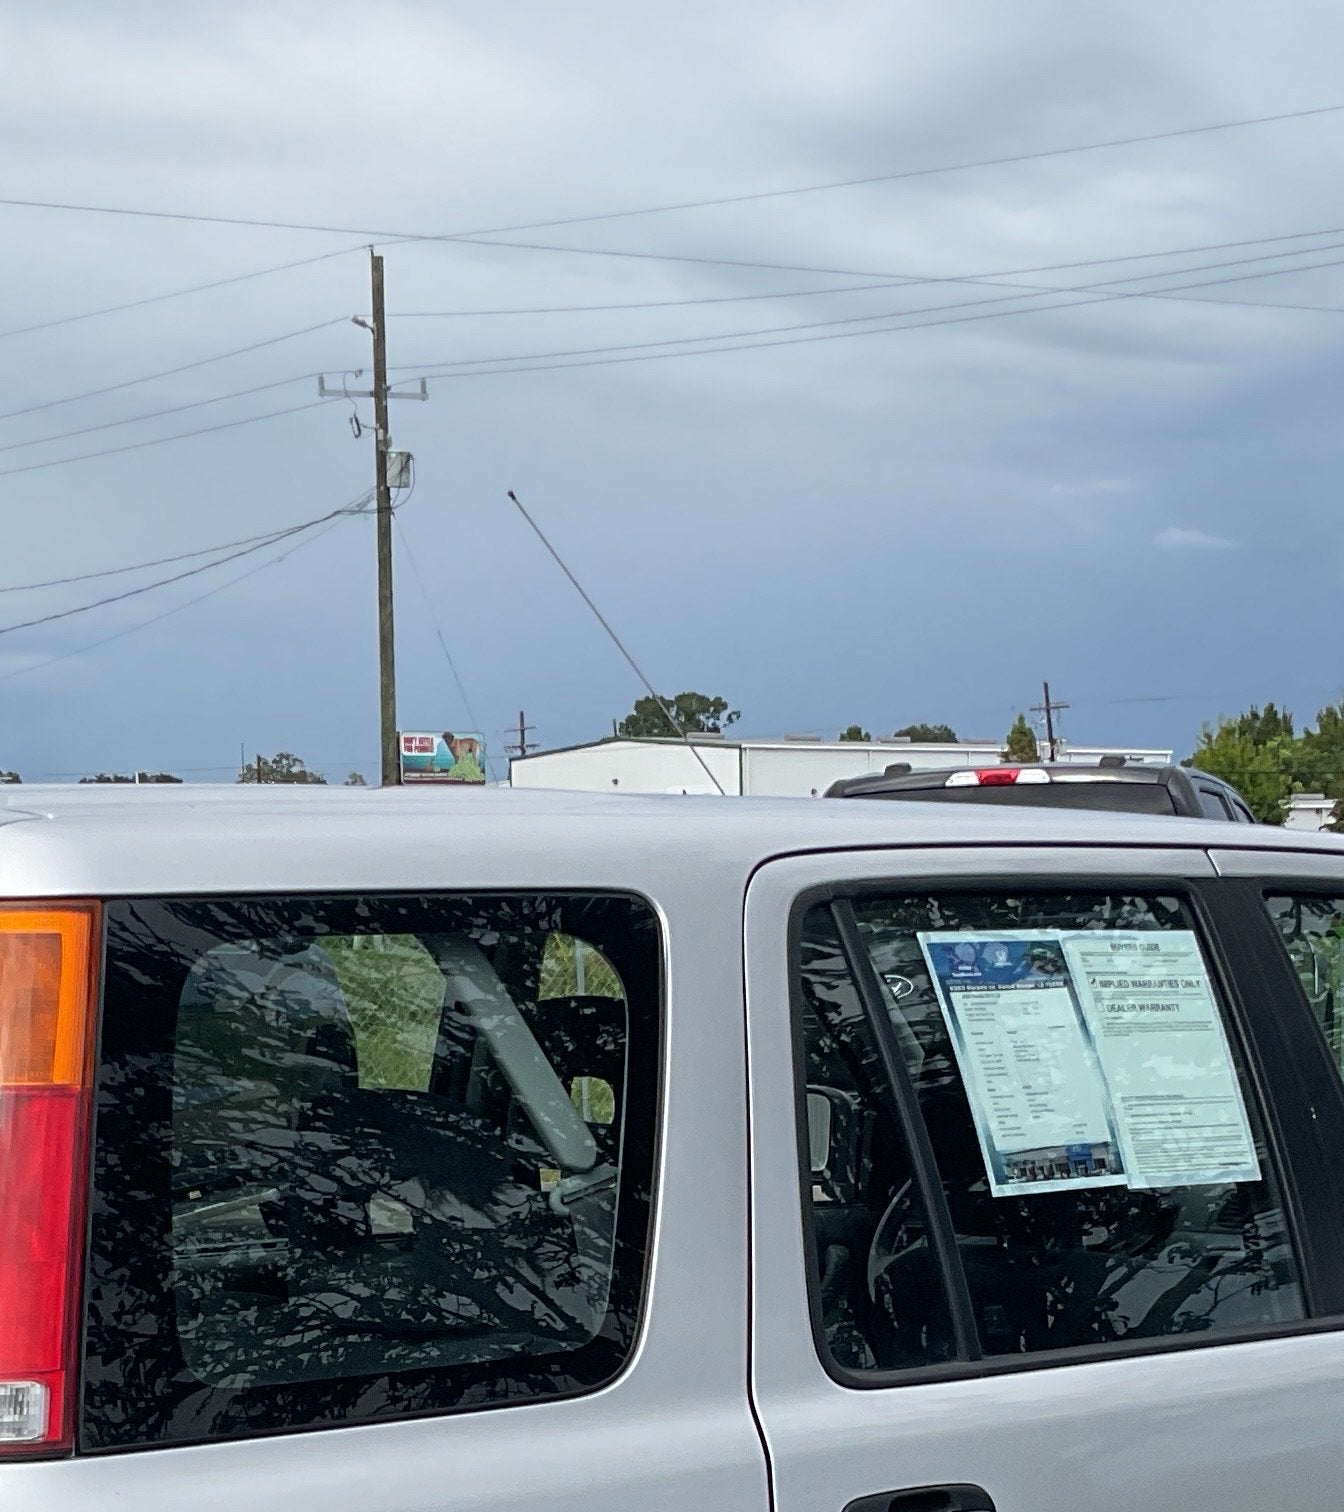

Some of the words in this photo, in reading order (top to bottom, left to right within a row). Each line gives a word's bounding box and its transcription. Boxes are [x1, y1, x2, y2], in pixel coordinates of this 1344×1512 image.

[1099, 980, 1130, 988] IMPLIED
[1132, 980, 1179, 988] WARRANTIES
[1181, 980, 1201, 988] ONLY
[1106, 1004, 1137, 1013] DEALER
[1139, 1004, 1180, 1013] WARRANTY
